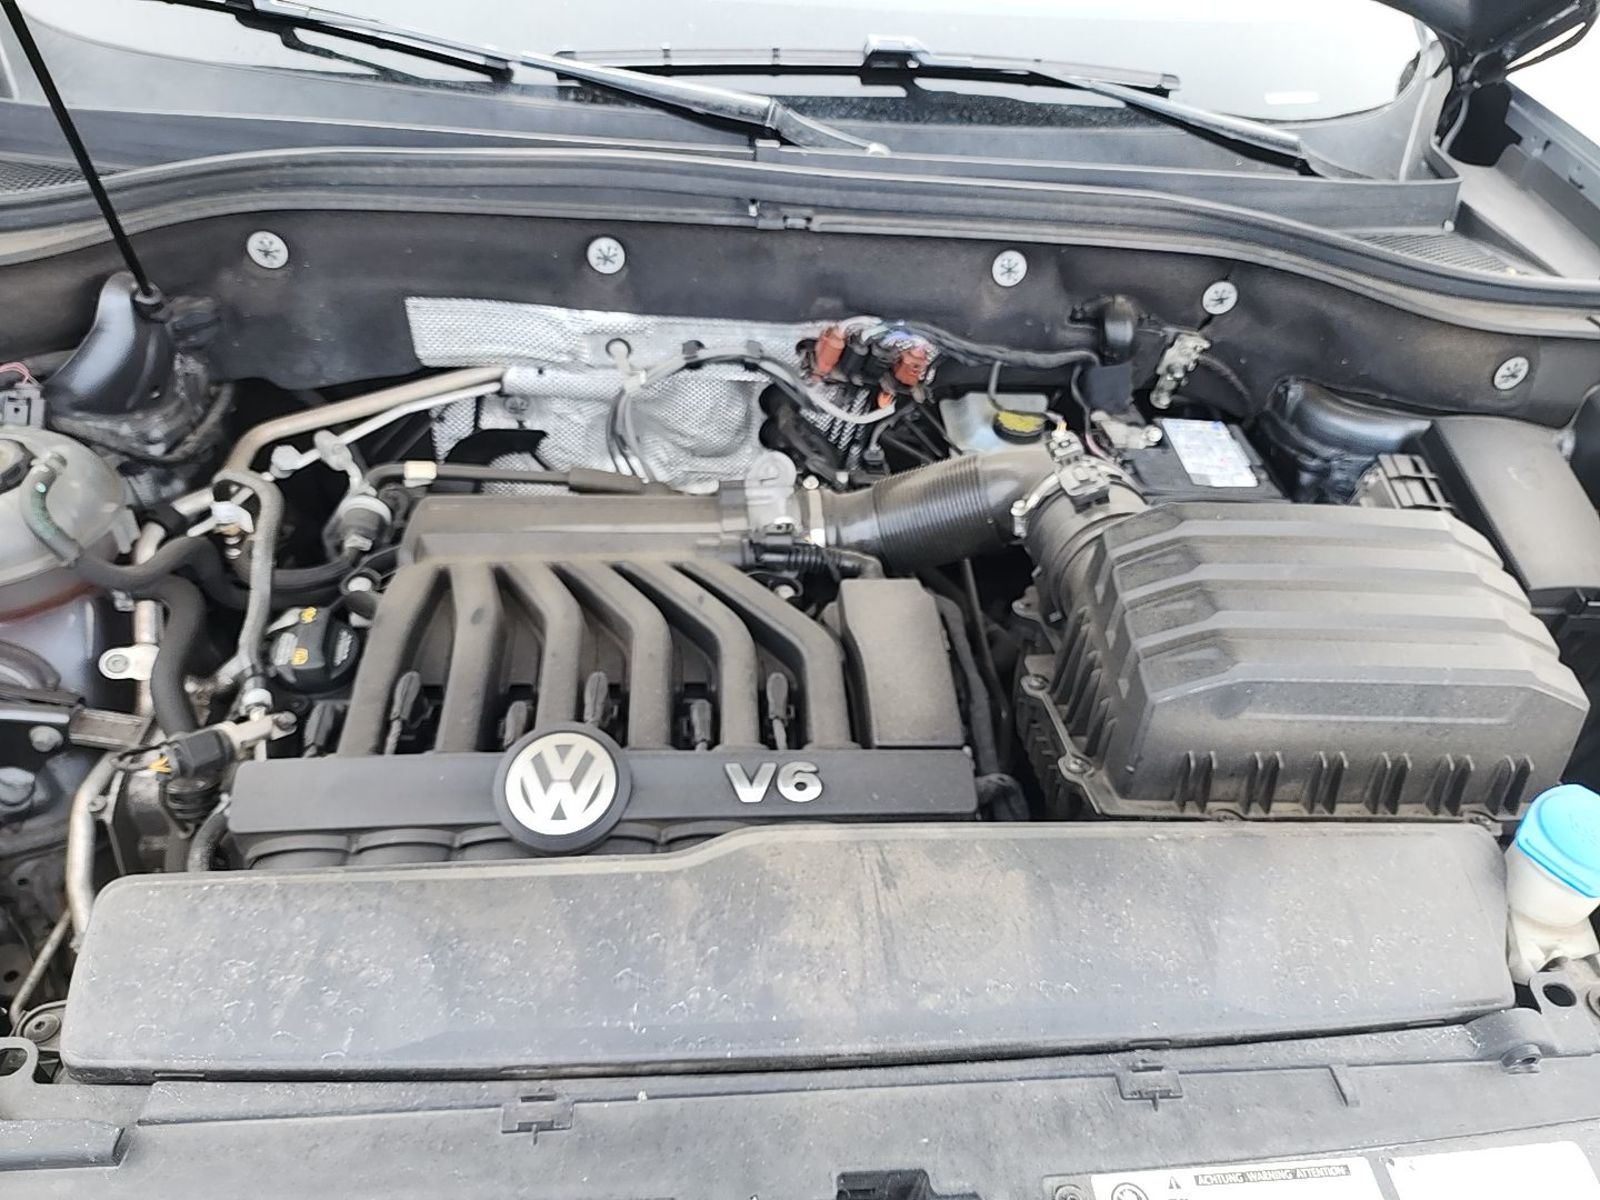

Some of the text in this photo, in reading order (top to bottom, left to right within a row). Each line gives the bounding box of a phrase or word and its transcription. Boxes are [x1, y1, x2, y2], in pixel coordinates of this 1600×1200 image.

[724, 761, 824, 803] V6
[1198, 1165, 1346, 1185] ACHTUNG WARNING ATTENTION
